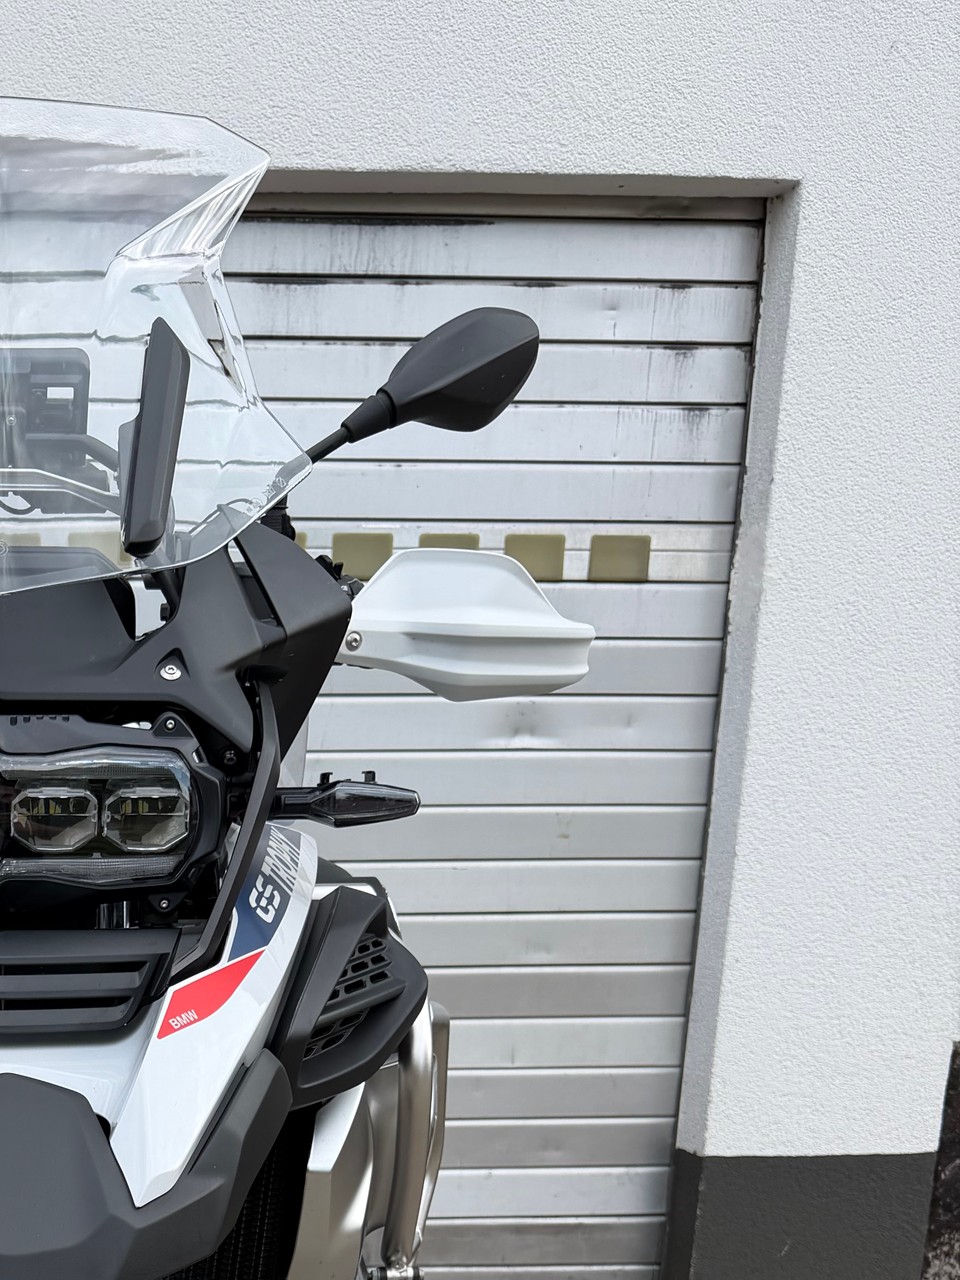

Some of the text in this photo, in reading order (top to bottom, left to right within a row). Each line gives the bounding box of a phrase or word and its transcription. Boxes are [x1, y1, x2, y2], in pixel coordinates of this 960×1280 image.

[248, 825, 301, 924] GS TROPHY
[168, 1009, 199, 1029] BMW
